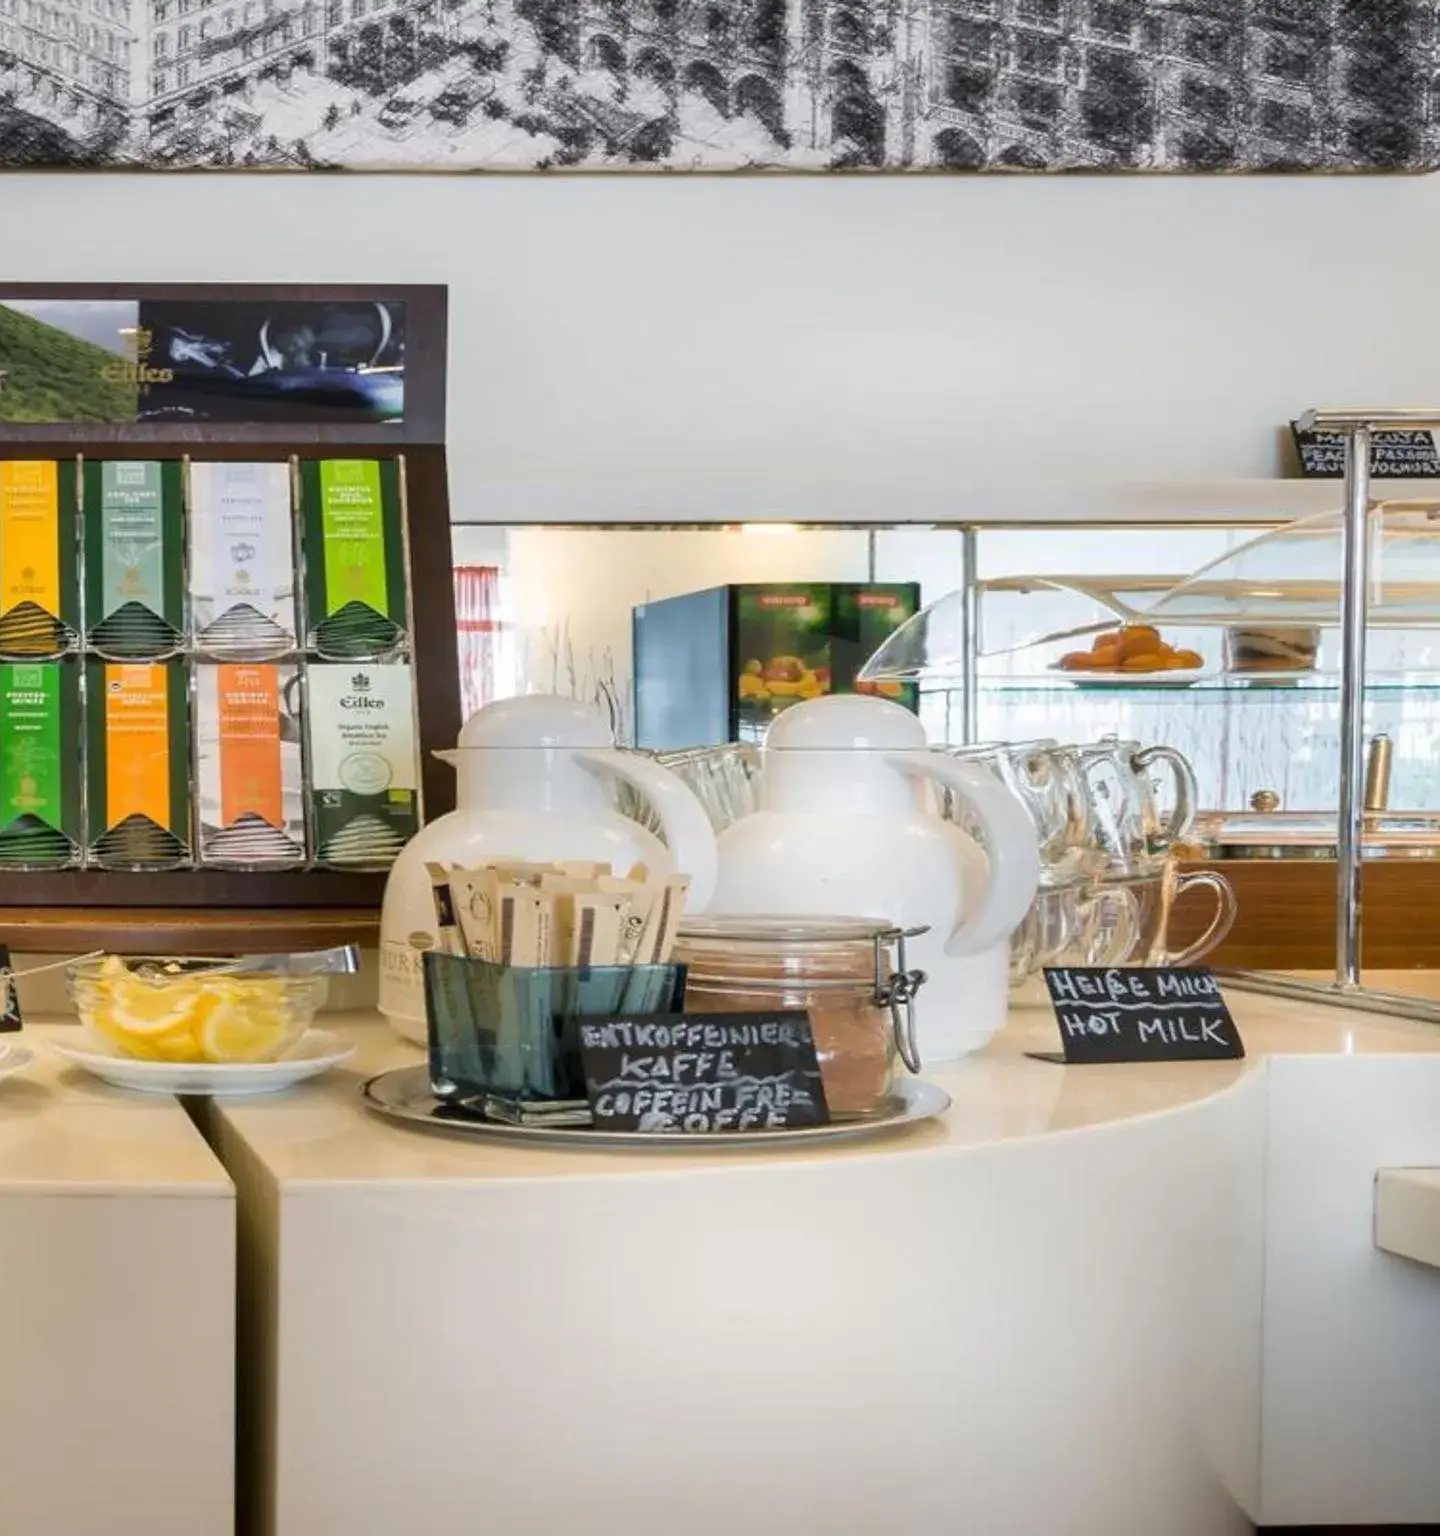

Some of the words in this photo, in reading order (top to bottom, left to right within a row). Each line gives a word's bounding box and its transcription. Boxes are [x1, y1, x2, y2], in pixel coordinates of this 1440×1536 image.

[1063, 1012, 1122, 1037] HOT
[1137, 1016, 1230, 1046] MILK
[620, 1050, 737, 1082] KAFFE
